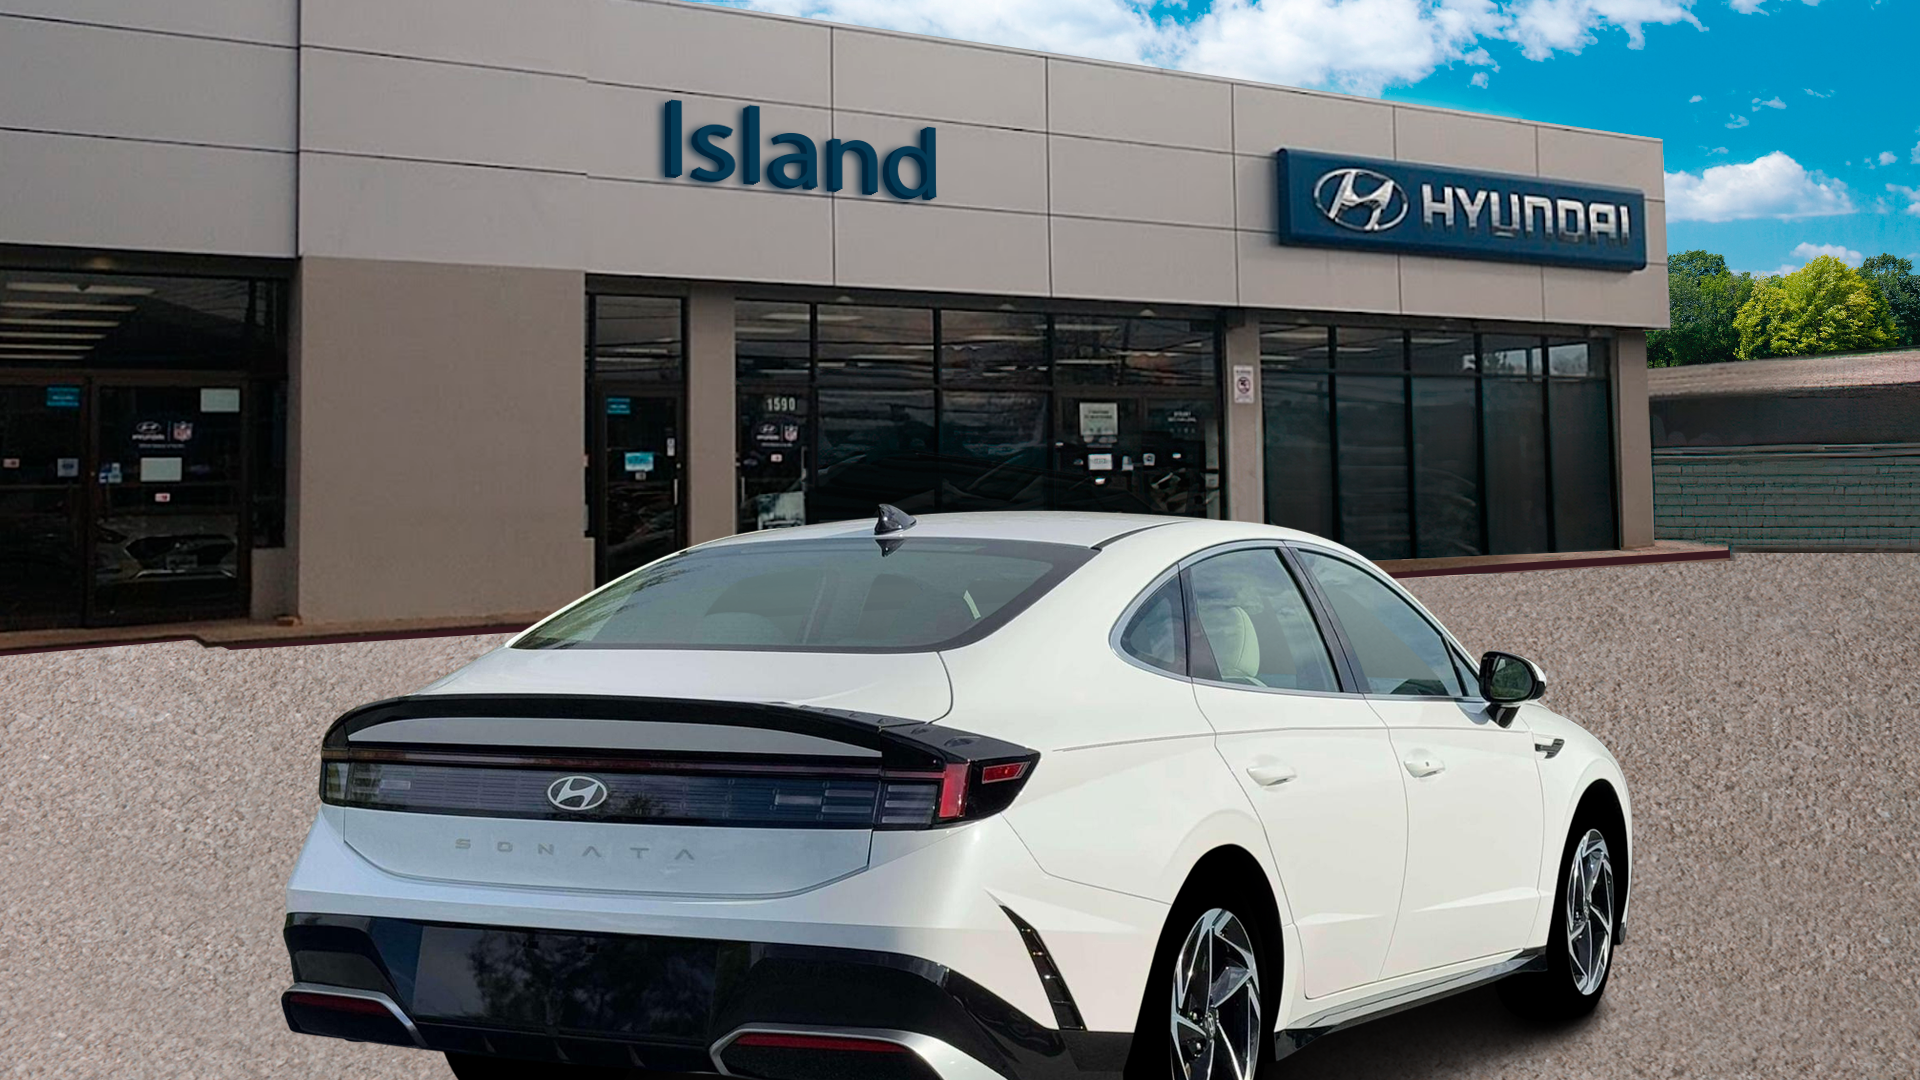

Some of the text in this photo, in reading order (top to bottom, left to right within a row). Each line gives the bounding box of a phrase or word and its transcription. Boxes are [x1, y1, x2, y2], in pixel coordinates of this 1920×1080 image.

[664, 99, 937, 200] Island
[1421, 183, 1631, 244] HYUNDAI
[766, 397, 796, 411] 1590
[455, 838, 695, 860] SONATA
